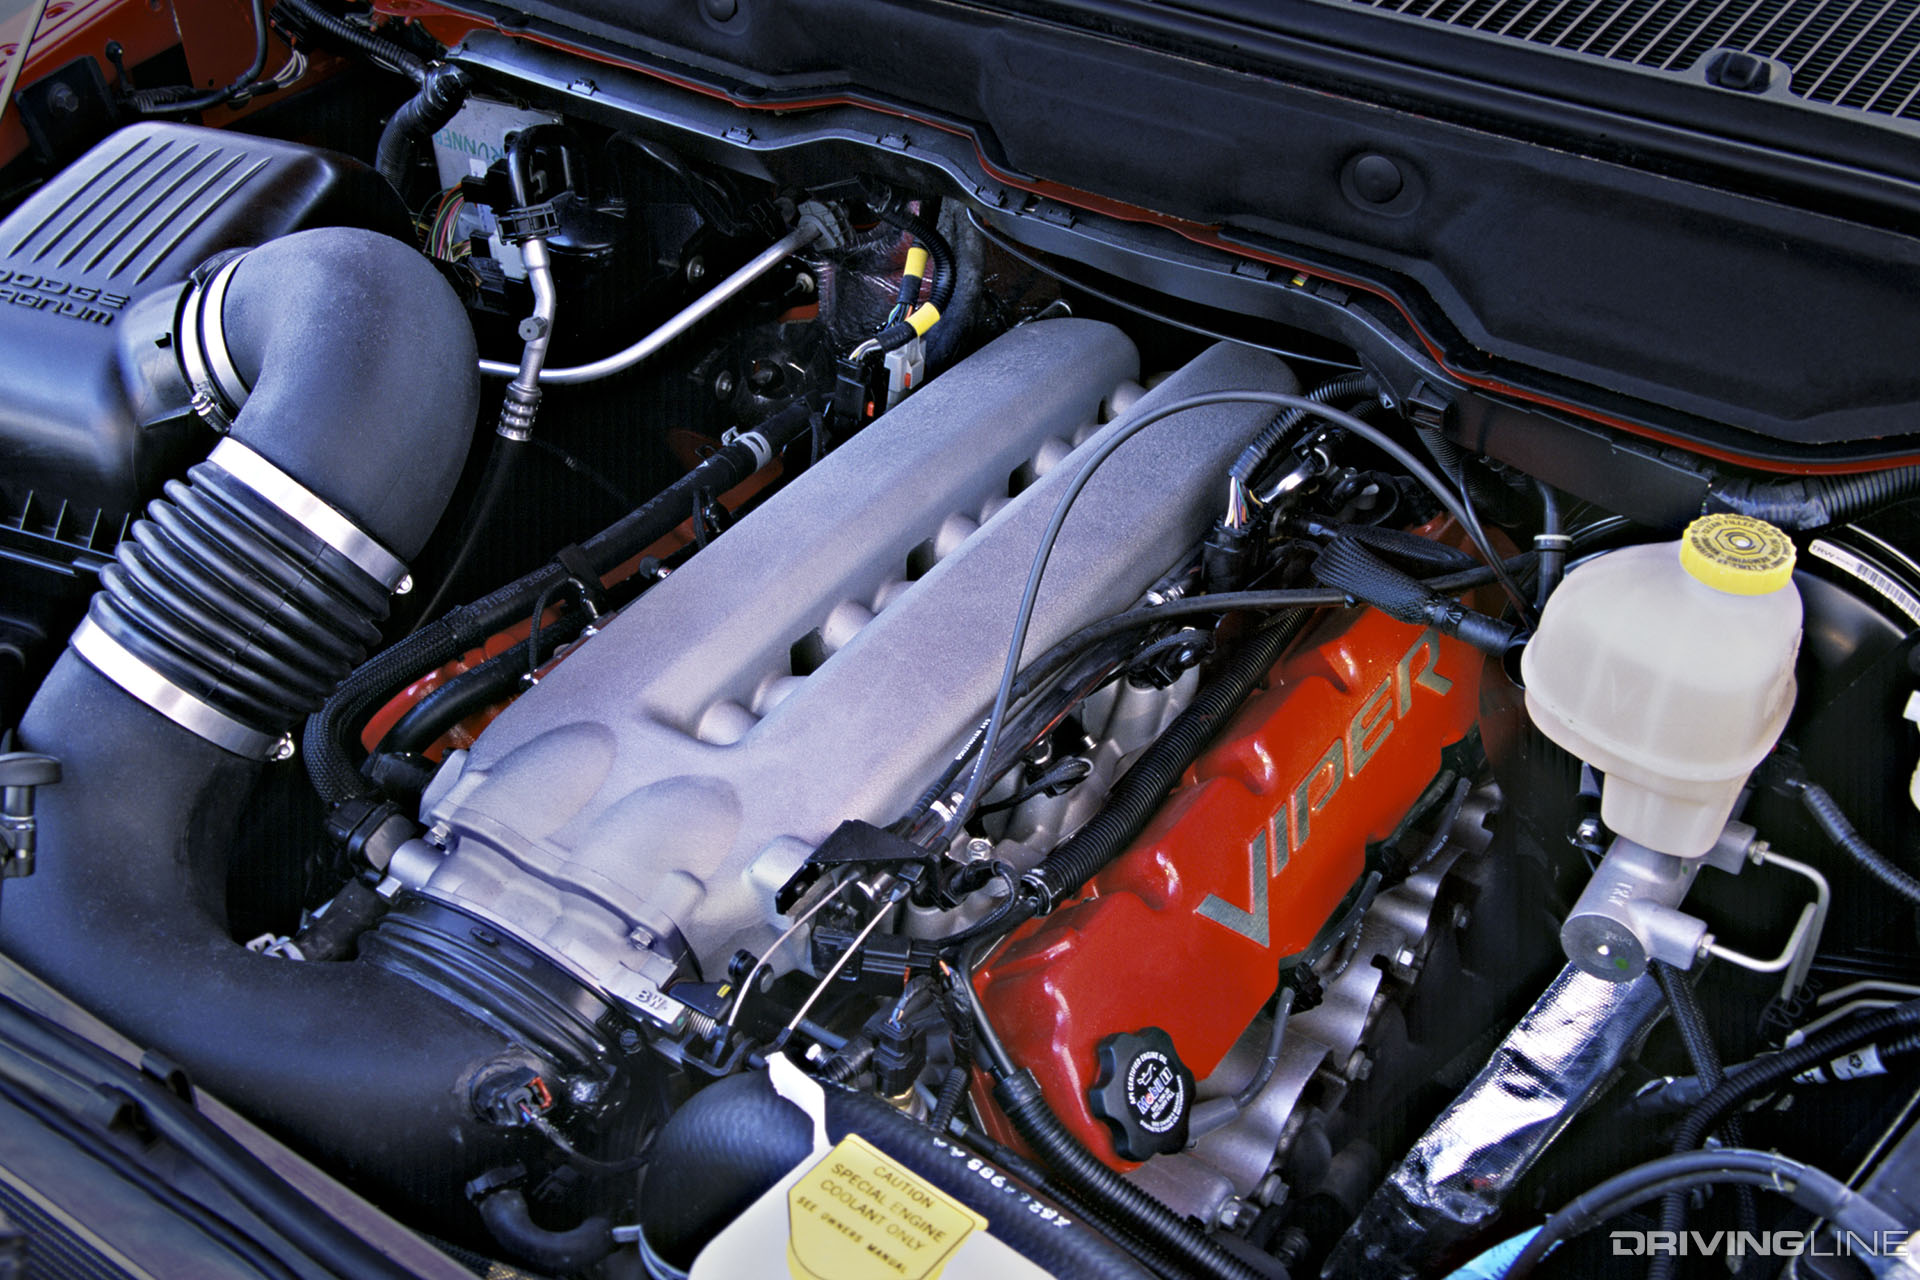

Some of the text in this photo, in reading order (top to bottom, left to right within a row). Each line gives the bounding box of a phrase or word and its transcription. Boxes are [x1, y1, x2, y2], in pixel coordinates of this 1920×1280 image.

[0, 289, 115, 326] AGNUM
[1192, 628, 1453, 948] VIPER
[1136, 1076, 1165, 1116] Mobil
[819, 1178, 928, 1253] COOLANT ONLY
[831, 1163, 947, 1244] SPECIAL ENGINE
[872, 1165, 937, 1210] CAUTION
[796, 1196, 909, 1275] SEE OWNERS MANUAL
